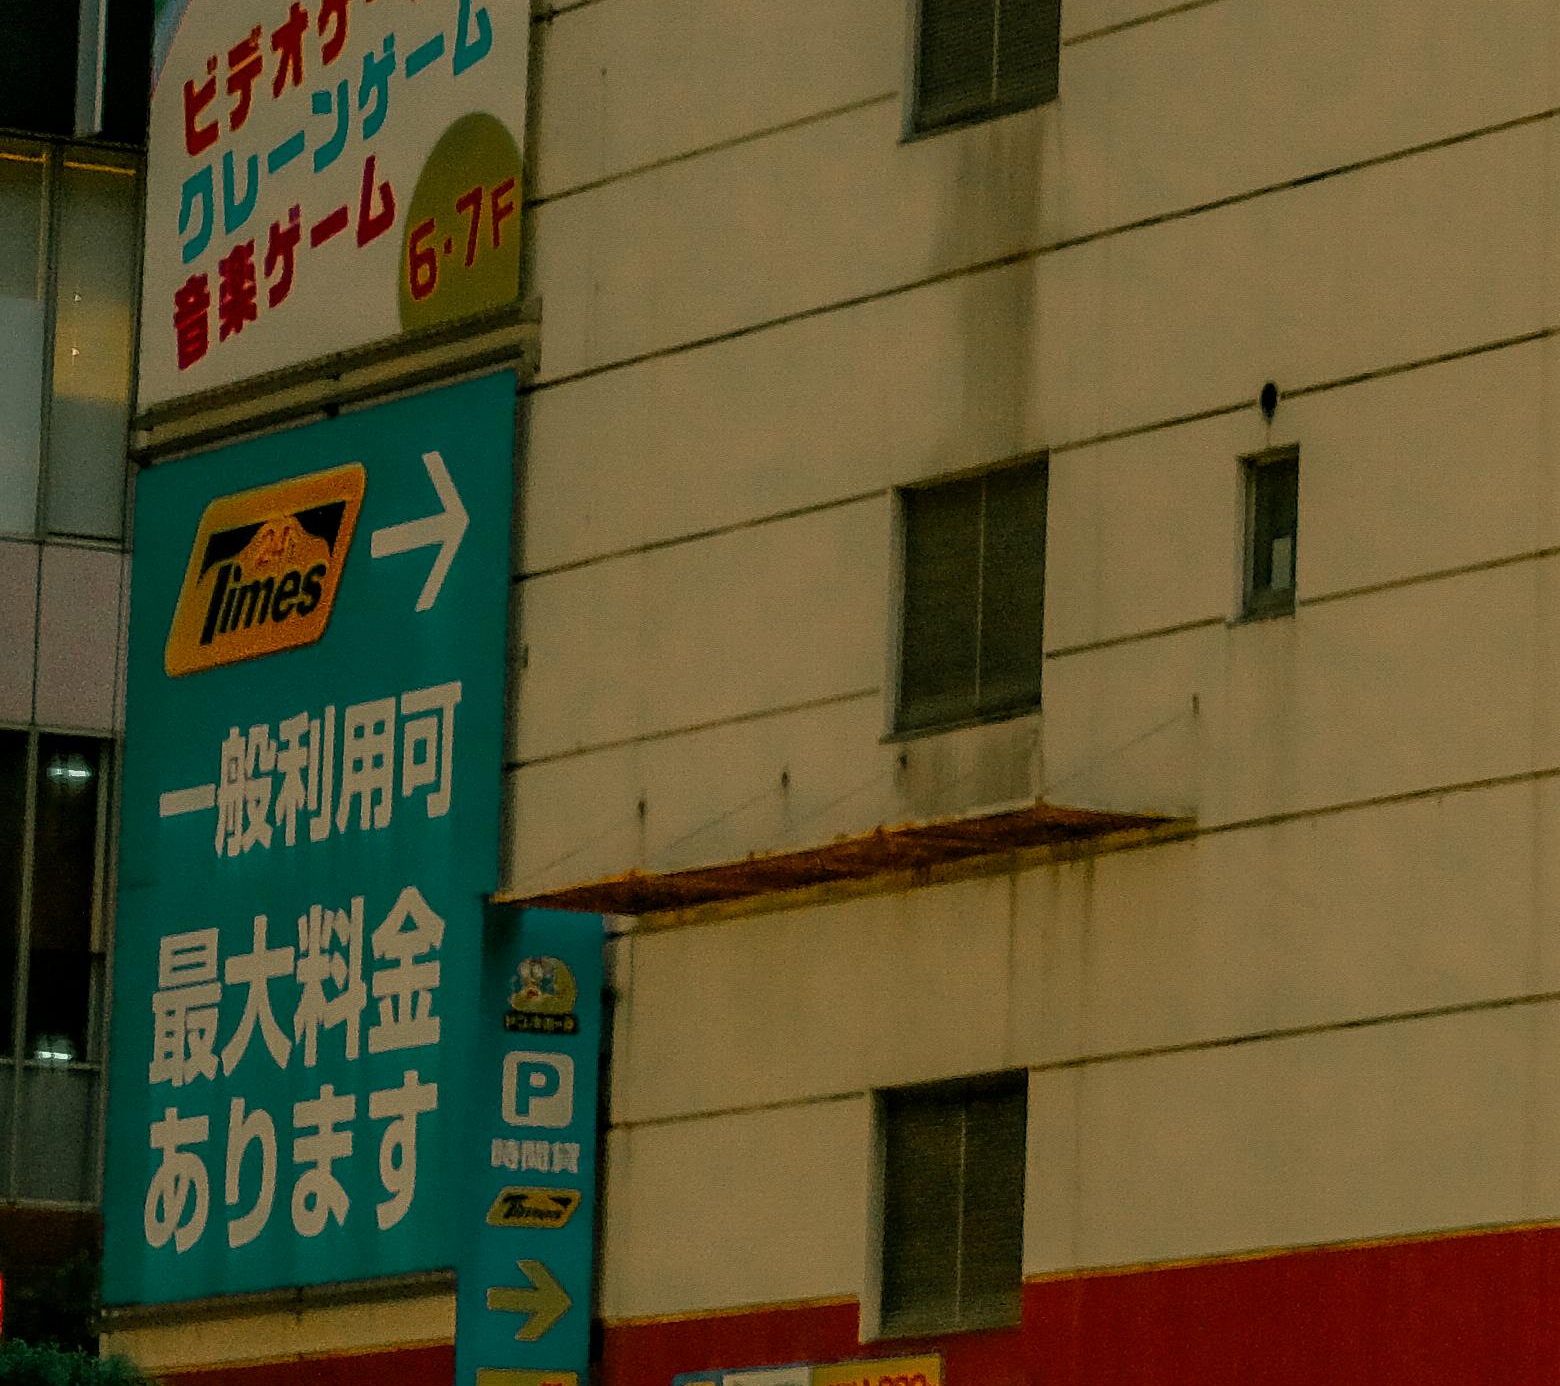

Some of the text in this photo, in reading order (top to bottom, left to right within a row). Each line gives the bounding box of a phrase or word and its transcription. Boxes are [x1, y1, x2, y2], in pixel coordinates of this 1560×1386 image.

[173, 154, 399, 369] 音楽ゲーム
[201, 554, 329, 645] Times
[159, 680, 463, 859] 一般利用可
[149, 884, 446, 1087] 最大料金
[144, 1070, 439, 1254] あります
[516, 1062, 560, 1115] P
